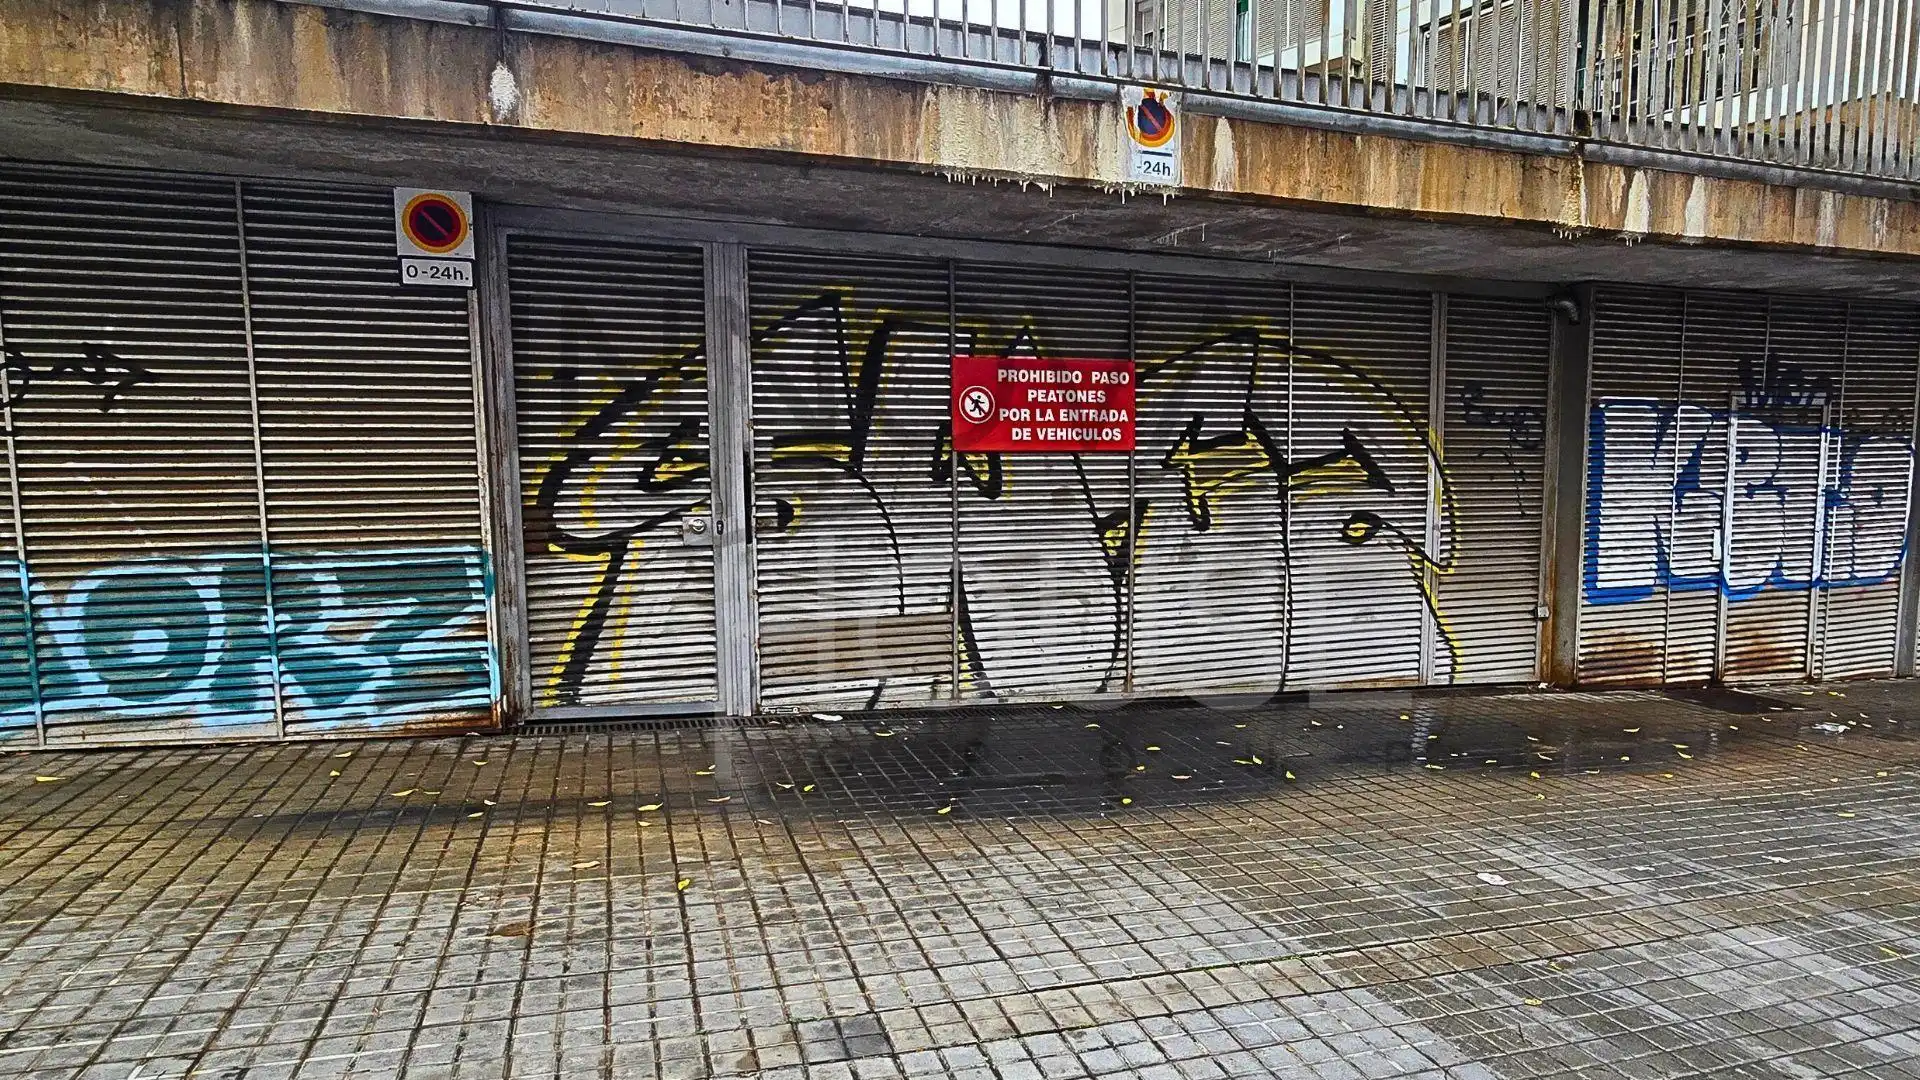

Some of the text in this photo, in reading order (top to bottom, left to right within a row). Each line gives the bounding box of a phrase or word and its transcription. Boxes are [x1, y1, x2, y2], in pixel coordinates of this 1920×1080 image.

[997, 369, 1130, 385] PROHIBIDO PASO
[1027, 389, 1106, 403] PEATONES
[999, 408, 1129, 423] POR LA ENTRADA
[1012, 427, 1122, 441] DE VEHICULOS
